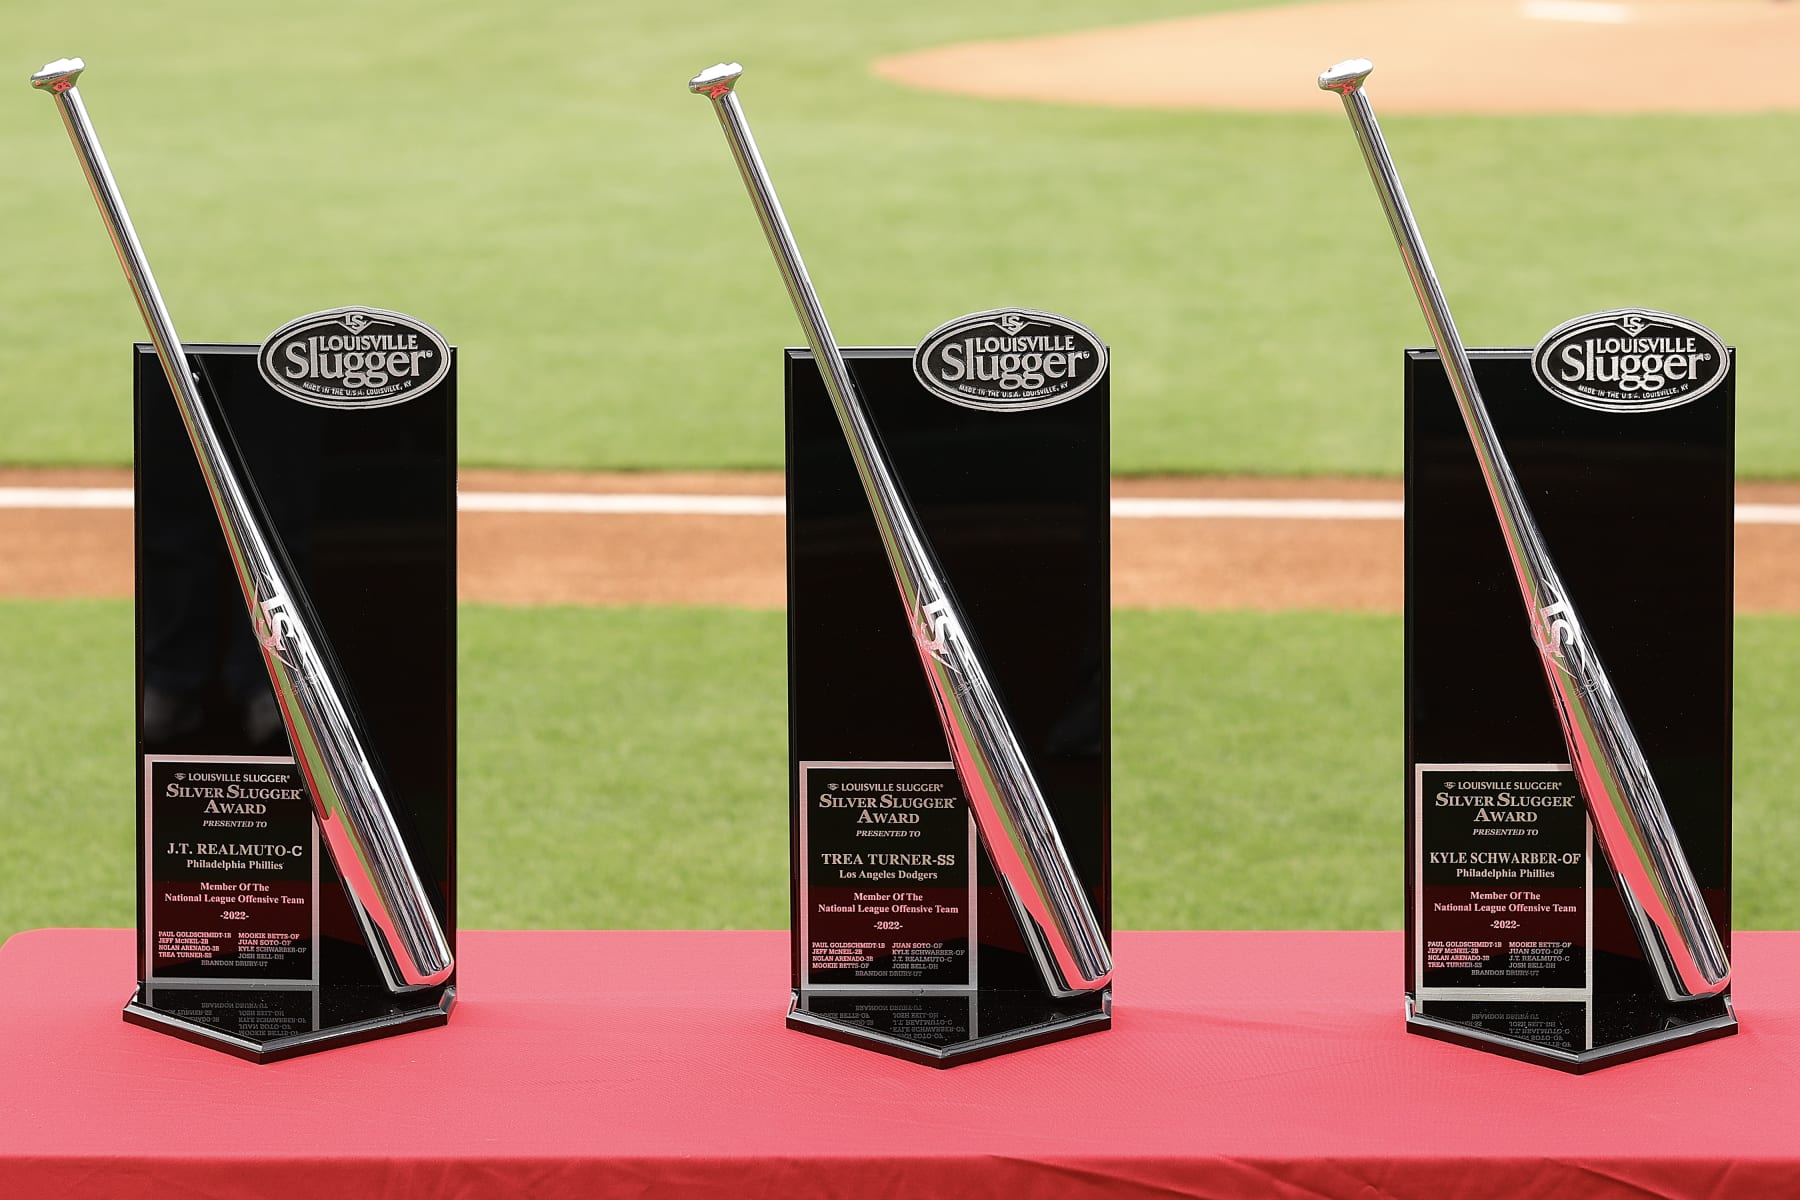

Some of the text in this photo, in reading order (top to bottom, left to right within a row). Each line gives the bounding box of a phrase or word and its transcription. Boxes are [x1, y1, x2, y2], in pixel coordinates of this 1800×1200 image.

[320, 335, 418, 351] LOUISVILLE
[976, 336, 1074, 352] LOUISVILLE
[1596, 338, 1696, 353] LOUISVILLE
[303, 382, 320, 392] MADE
[404, 380, 411, 388] KY
[959, 385, 976, 394] MADE
[1061, 381, 1068, 389] KY
[1578, 385, 1595, 394] MADE
[1681, 384, 1688, 392] KY
[189, 773, 240, 782] LOUISVILLE
[166, 784, 223, 798] SILVER
[819, 794, 877, 808] SILVER
[1436, 792, 1493, 806] SILVER
[204, 800, 266, 814] AWARD
[857, 809, 919, 823] AWARD
[1474, 808, 1537, 822] AWARD
[167, 843, 302, 856] J.T. REALMUTO-C
[822, 854, 955, 866] TREA TURNER-SS
[1430, 853, 1581, 864] KYLE SCHWARBER-OF
[187, 860, 283, 870] Philadelphia Phillies
[840, 870, 937, 881] Los Angeles Dodgers
[1457, 869, 1554, 879] Philadelphia Phillies
[201, 883, 237, 891] Member
[239, 883, 251, 891] Of
[205, 895, 235, 904] League
[238, 895, 278, 904] Offensive
[281, 896, 304, 904] Team
[906, 893, 923, 901] The
[1471, 892, 1540, 900] Member Of The
[818, 904, 958, 914] National League Offensive Team
[1434, 903, 1576, 913] National League Offensive Team
[220, 911, 249, 919] -2022-
[874, 922, 903, 930] -2022-
[1490, 920, 1520, 928] -2022-
